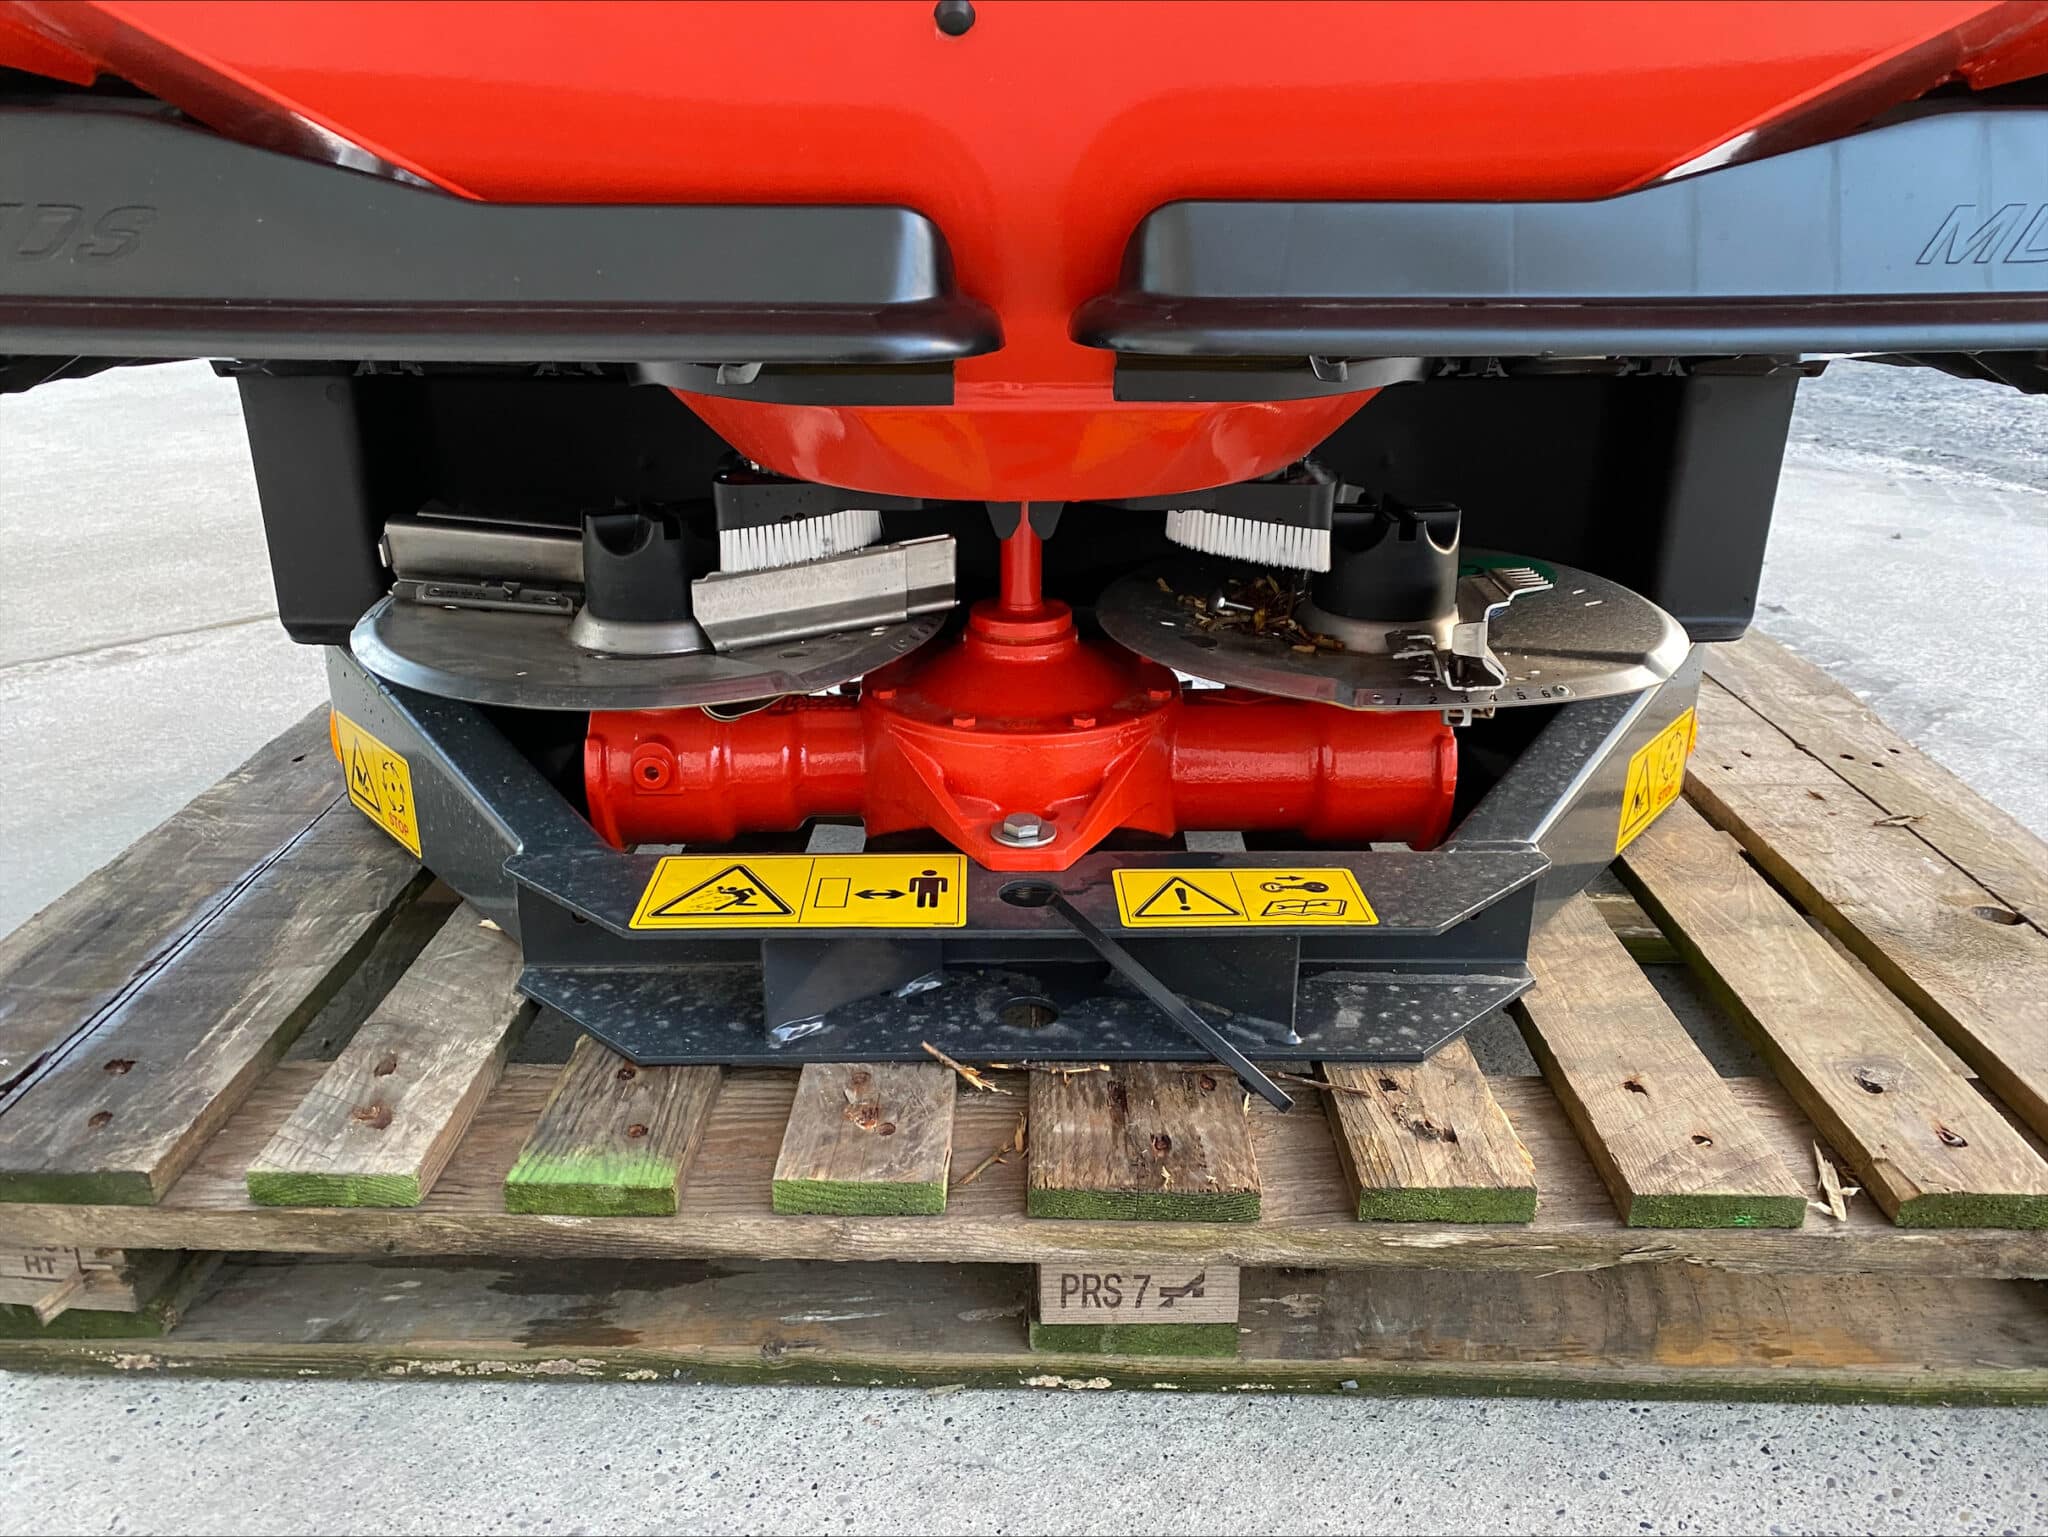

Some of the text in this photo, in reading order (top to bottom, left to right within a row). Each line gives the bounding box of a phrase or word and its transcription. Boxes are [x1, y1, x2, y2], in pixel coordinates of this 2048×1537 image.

[0, 202, 158, 263] DS
[1429, 696, 1438, 705] 2
[1461, 694, 1470, 704] 3
[1489, 692, 1498, 702] 4
[1516, 691, 1526, 701] 5
[1541, 690, 1552, 699] 6
[24, 1255, 57, 1275] HT
[1060, 1273, 1151, 1309] PRS 7
